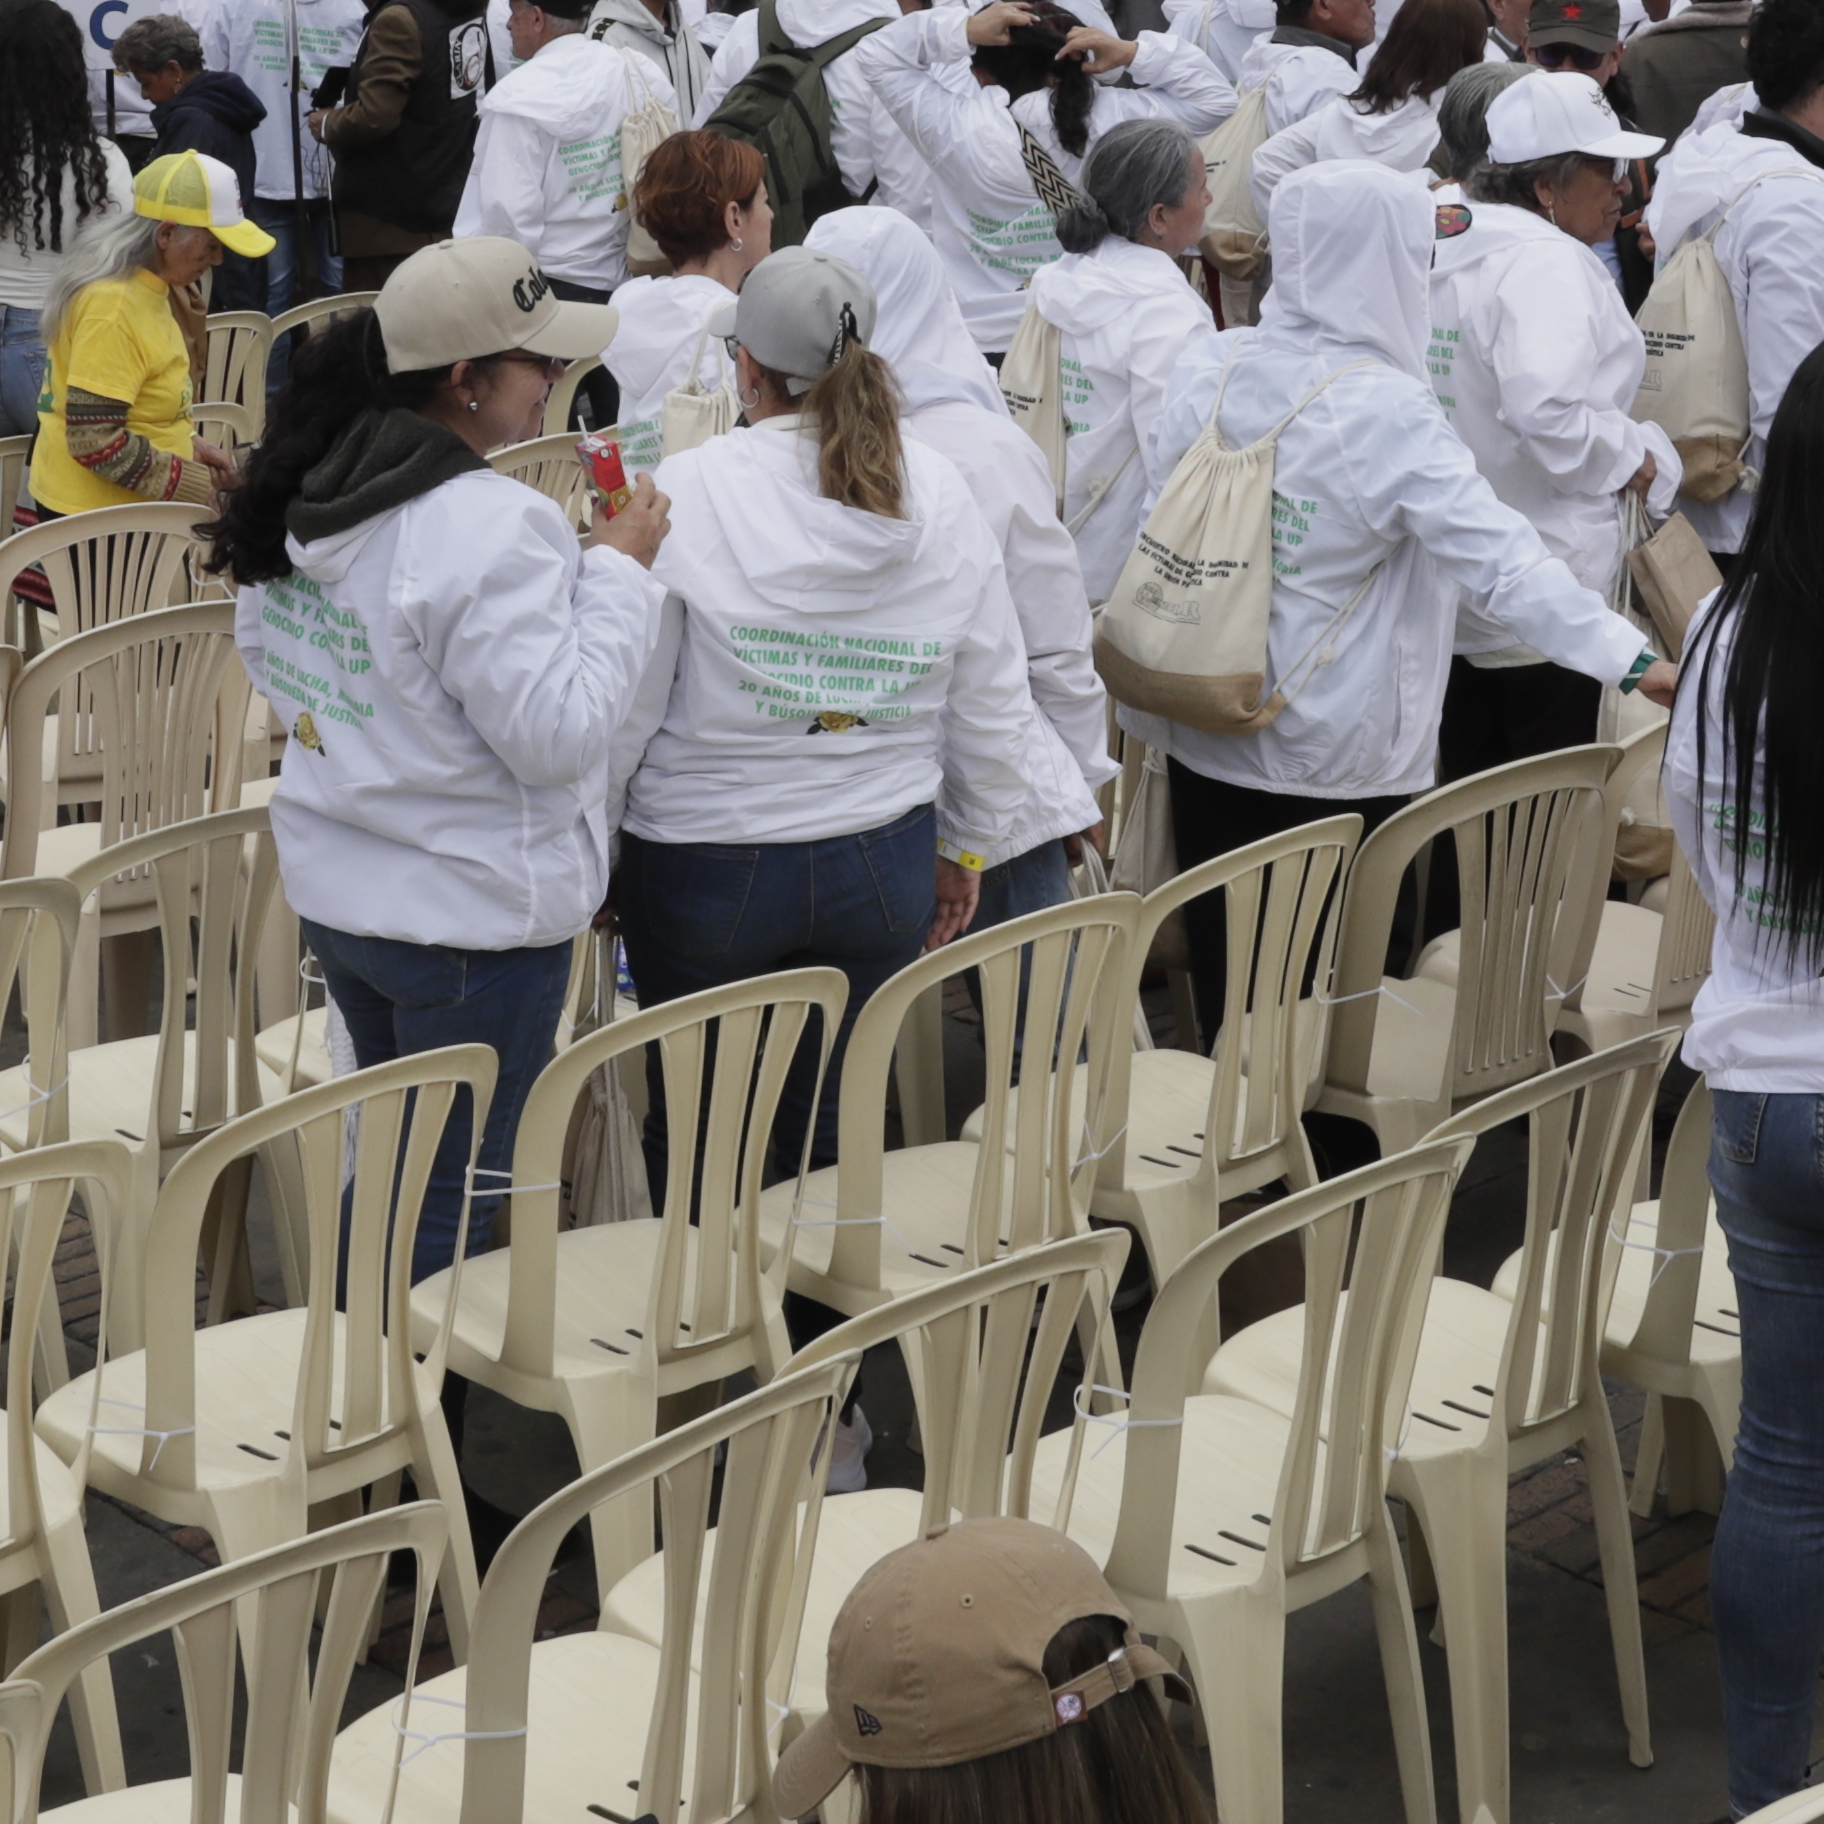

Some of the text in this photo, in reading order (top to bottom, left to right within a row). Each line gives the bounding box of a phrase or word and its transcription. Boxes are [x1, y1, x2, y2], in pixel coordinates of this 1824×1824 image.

[1447, 330, 1459, 343] DE
[1077, 378, 1094, 391] DEL
[1074, 393, 1089, 404] UP
[1301, 500, 1318, 514] DE
[1291, 515, 1310, 532] DEL
[1287, 532, 1303, 547] UP
[301, 603, 312, 617] Y
[351, 637, 371, 653] DE
[730, 625, 942, 656] COORDINACIÓN NACIONAL DE
[349, 659, 371, 674] UP
[733, 644, 798, 666] VÍCTIMAS
[804, 653, 814, 667] Y
[817, 655, 904, 674] FAMILIARES
[738, 680, 757, 692] 20
[762, 685, 800, 703] AÑOS
[806, 690, 821, 704] DE
[819, 675, 875, 692] CONTRA
[882, 679, 899, 694] LA
[755, 701, 765, 714] Y
